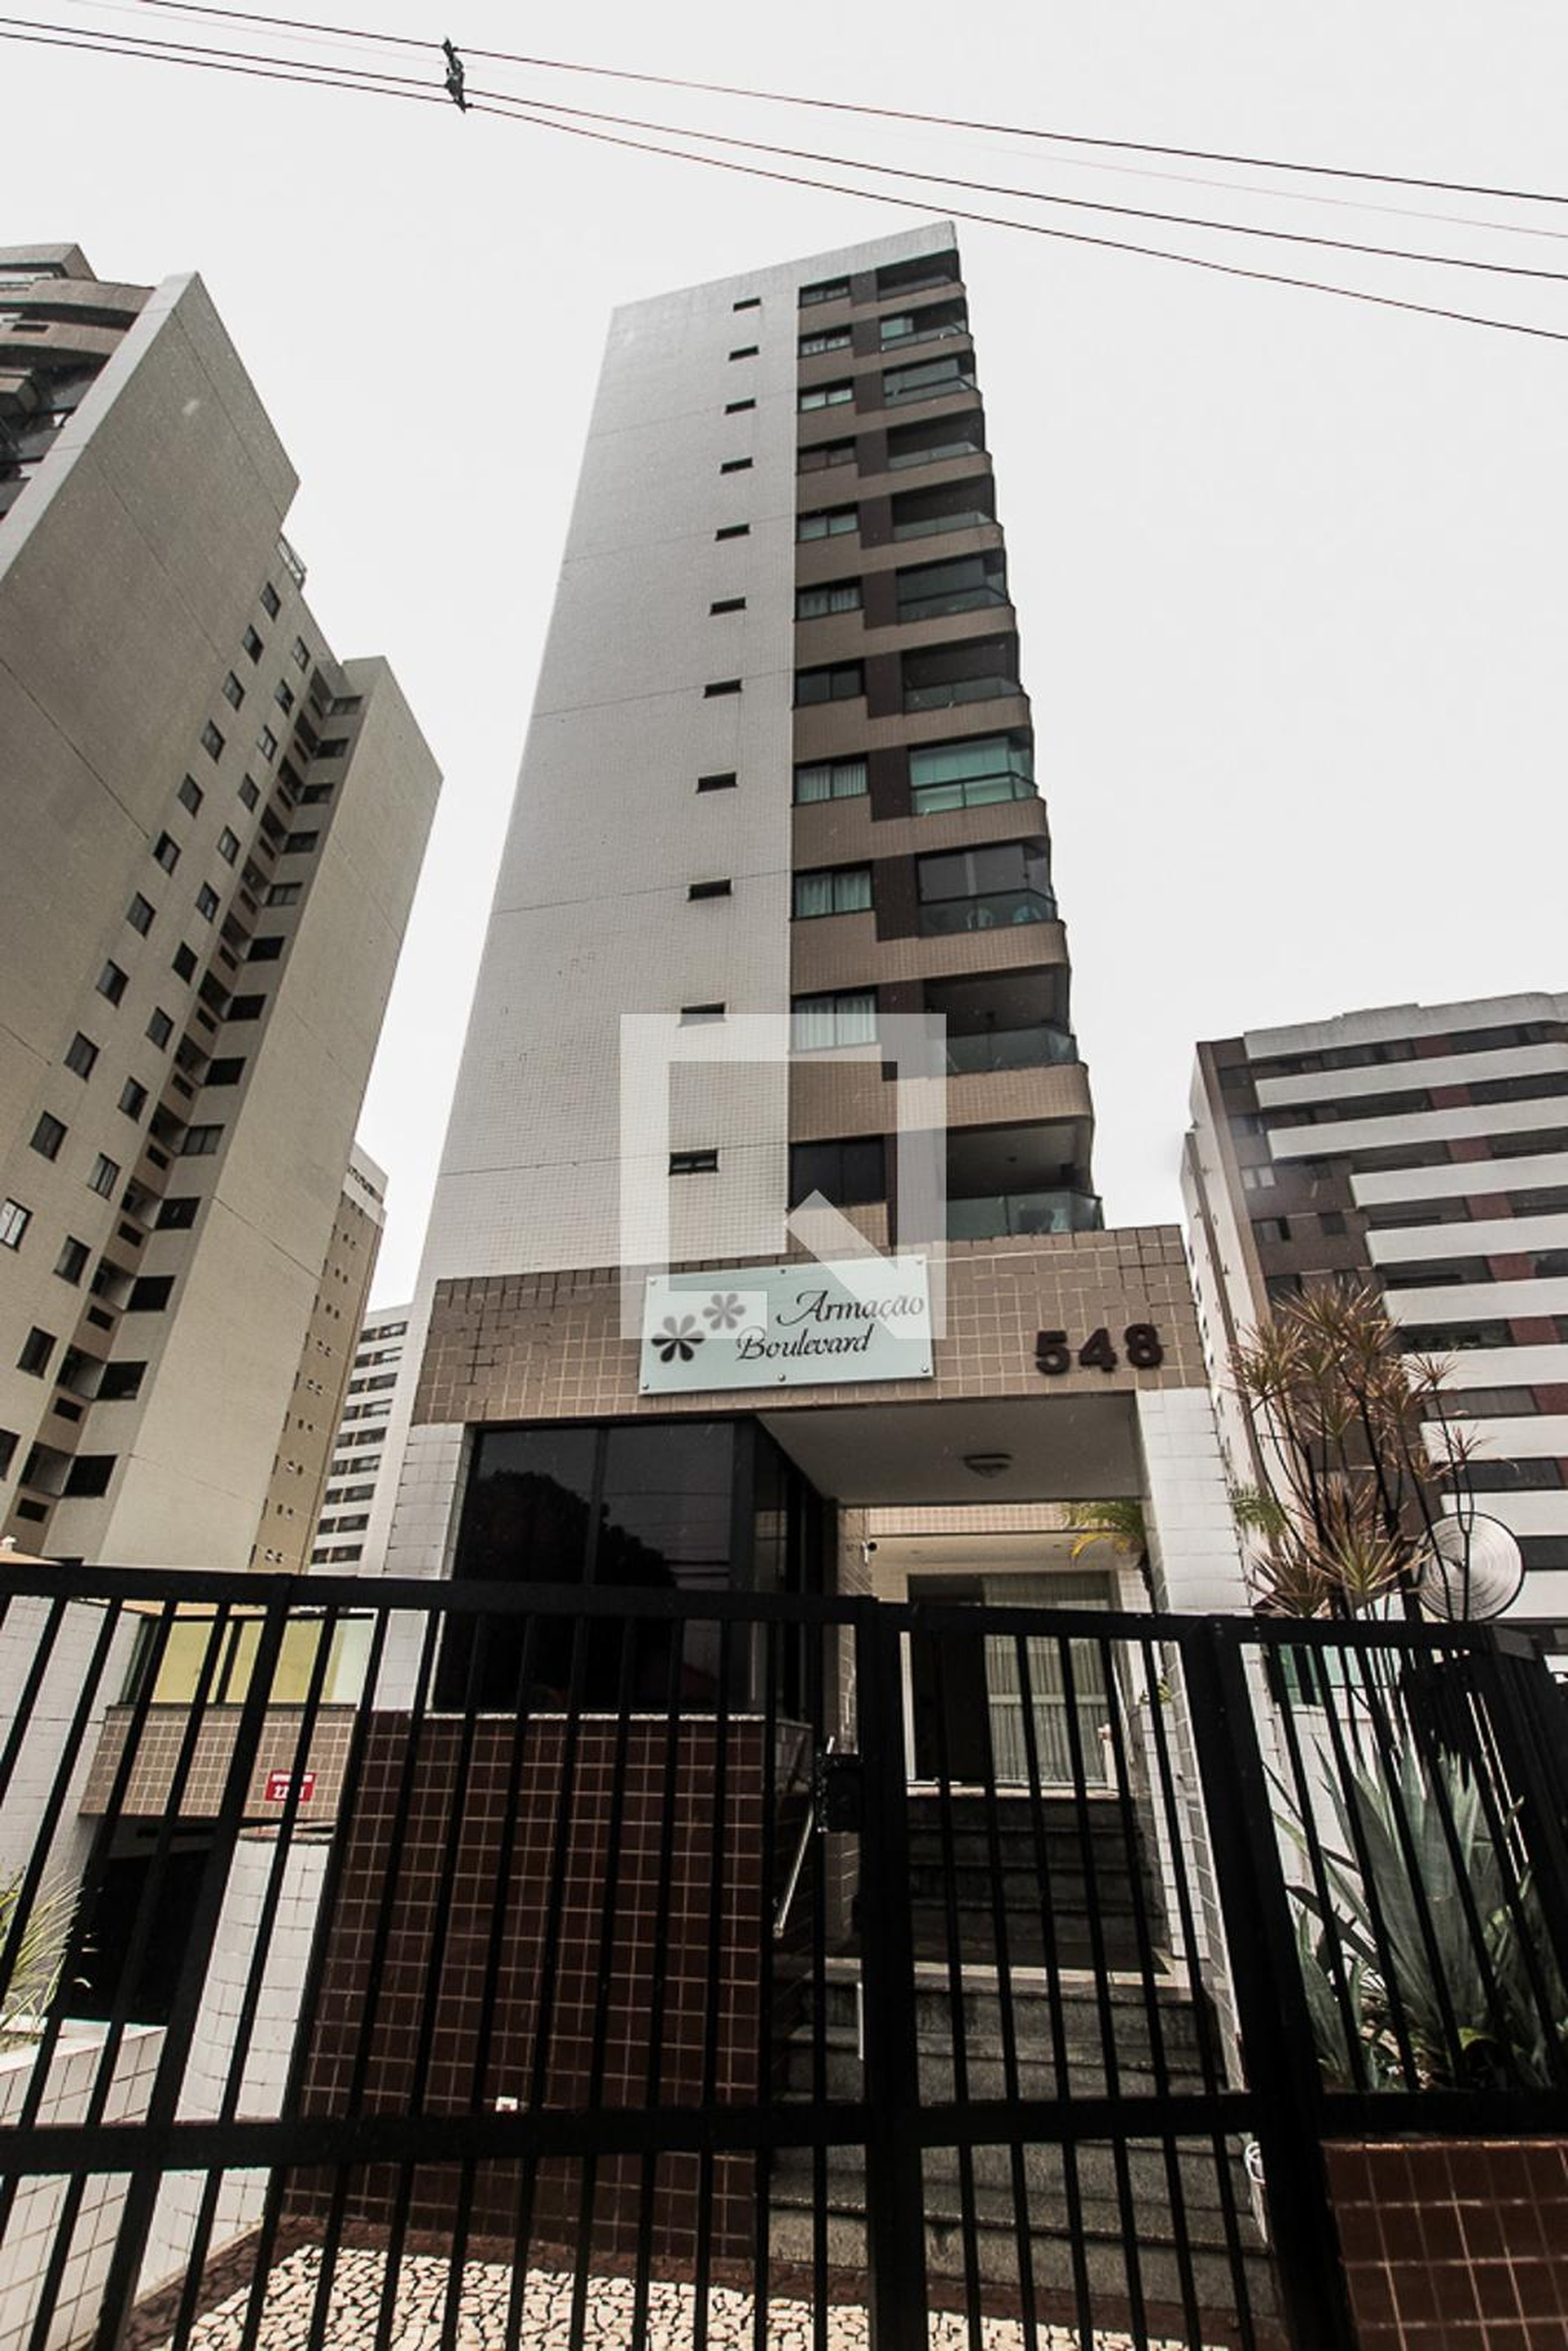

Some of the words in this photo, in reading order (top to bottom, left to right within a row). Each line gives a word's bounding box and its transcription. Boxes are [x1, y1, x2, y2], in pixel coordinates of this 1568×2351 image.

[776, 1290, 924, 1326] Armação
[736, 1323, 875, 1361] Boulevard
[1035, 1323, 1164, 1375] 548
